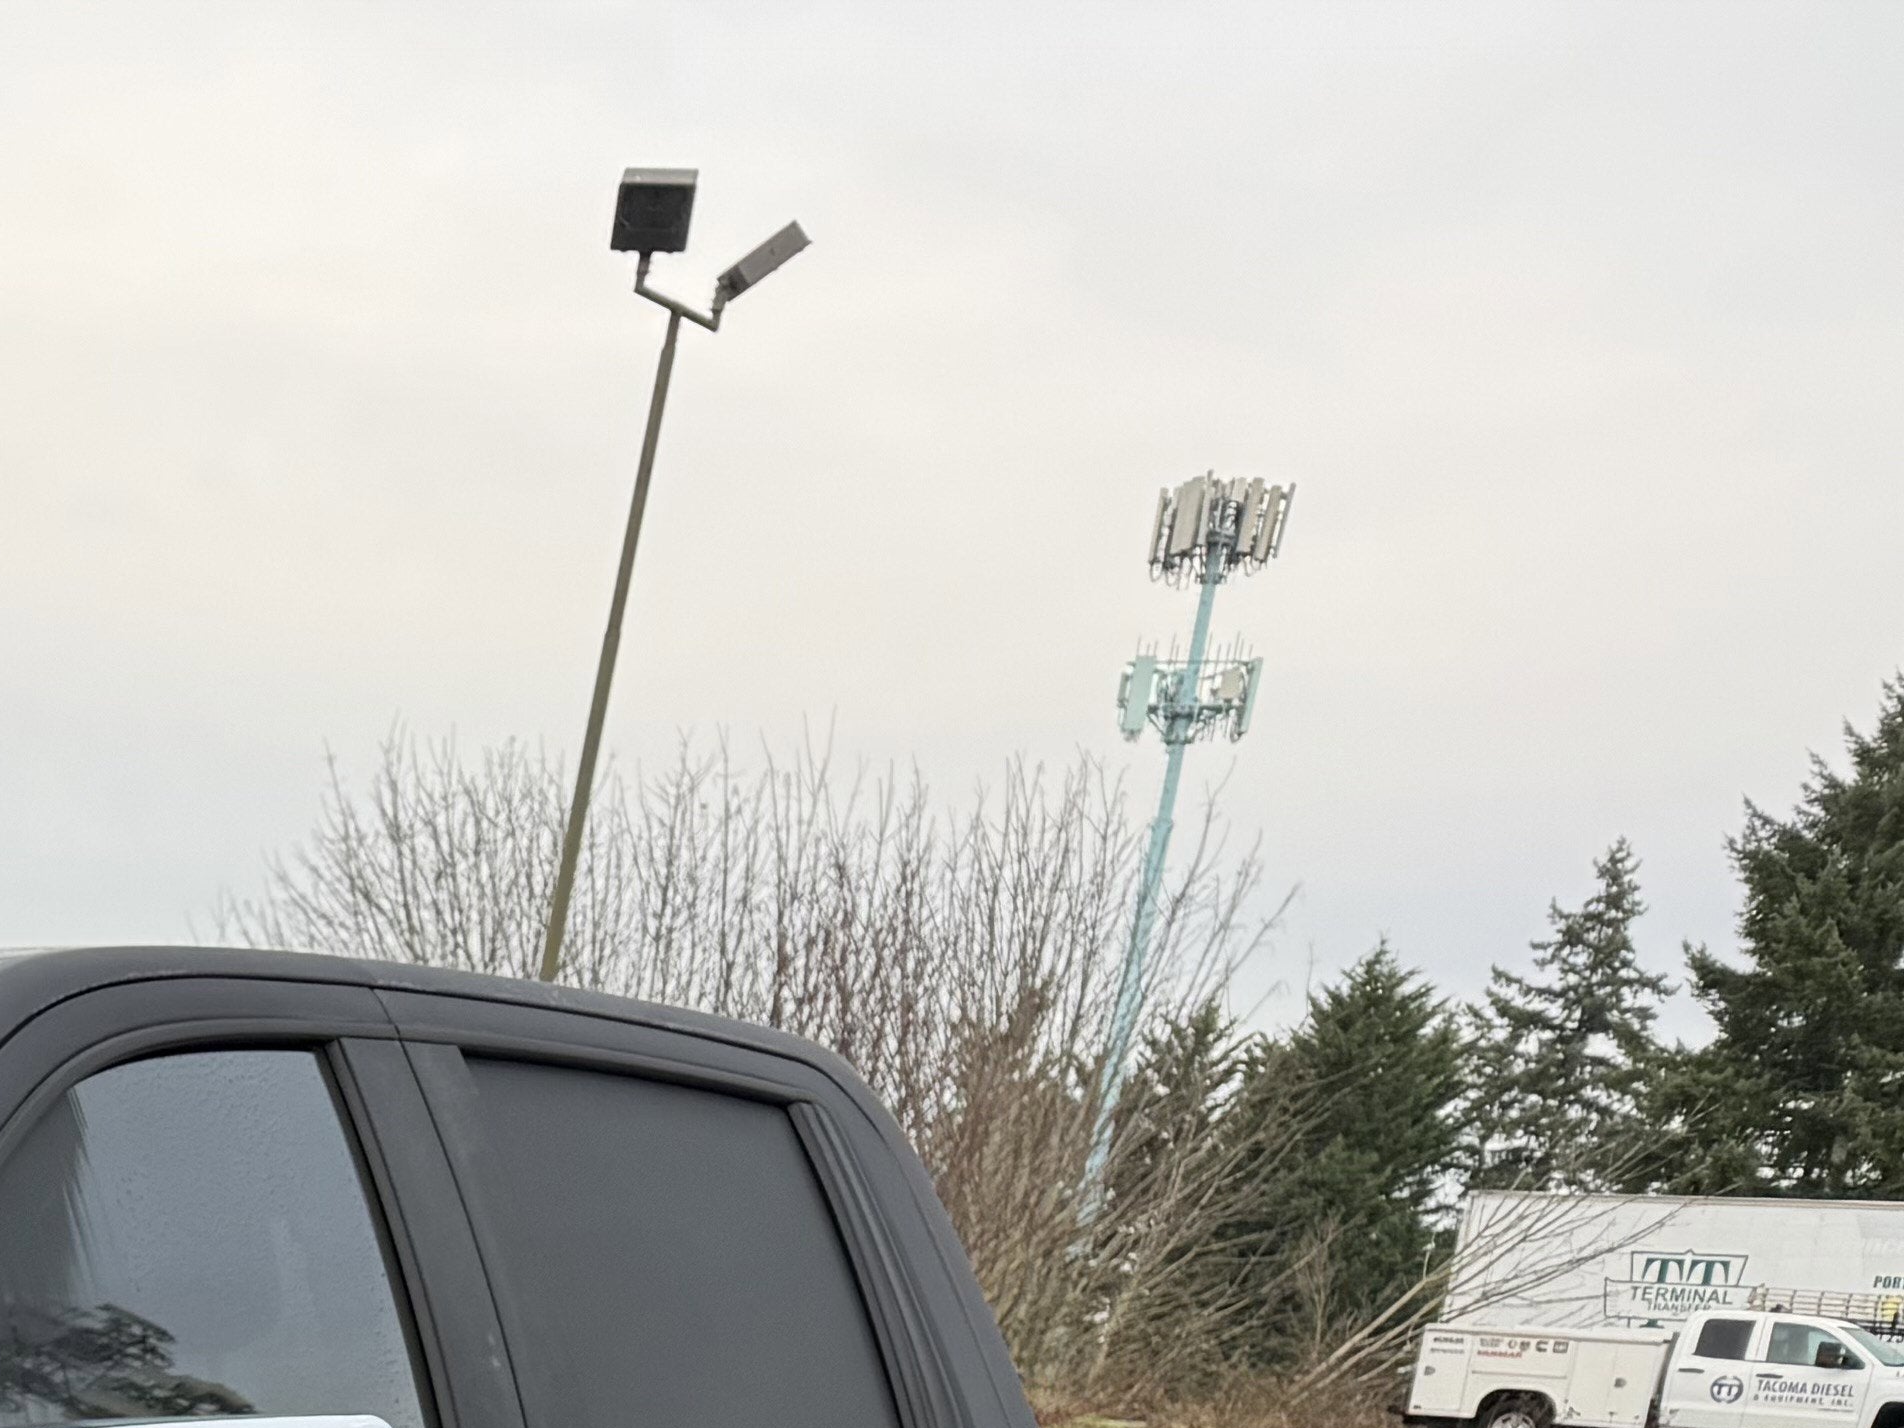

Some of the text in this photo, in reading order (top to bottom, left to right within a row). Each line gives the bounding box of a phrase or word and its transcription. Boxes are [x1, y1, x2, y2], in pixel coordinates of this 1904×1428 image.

[1630, 1285, 1733, 1306] TERMINAL
[1758, 1379, 1854, 1397] TACOMA DIESEL
